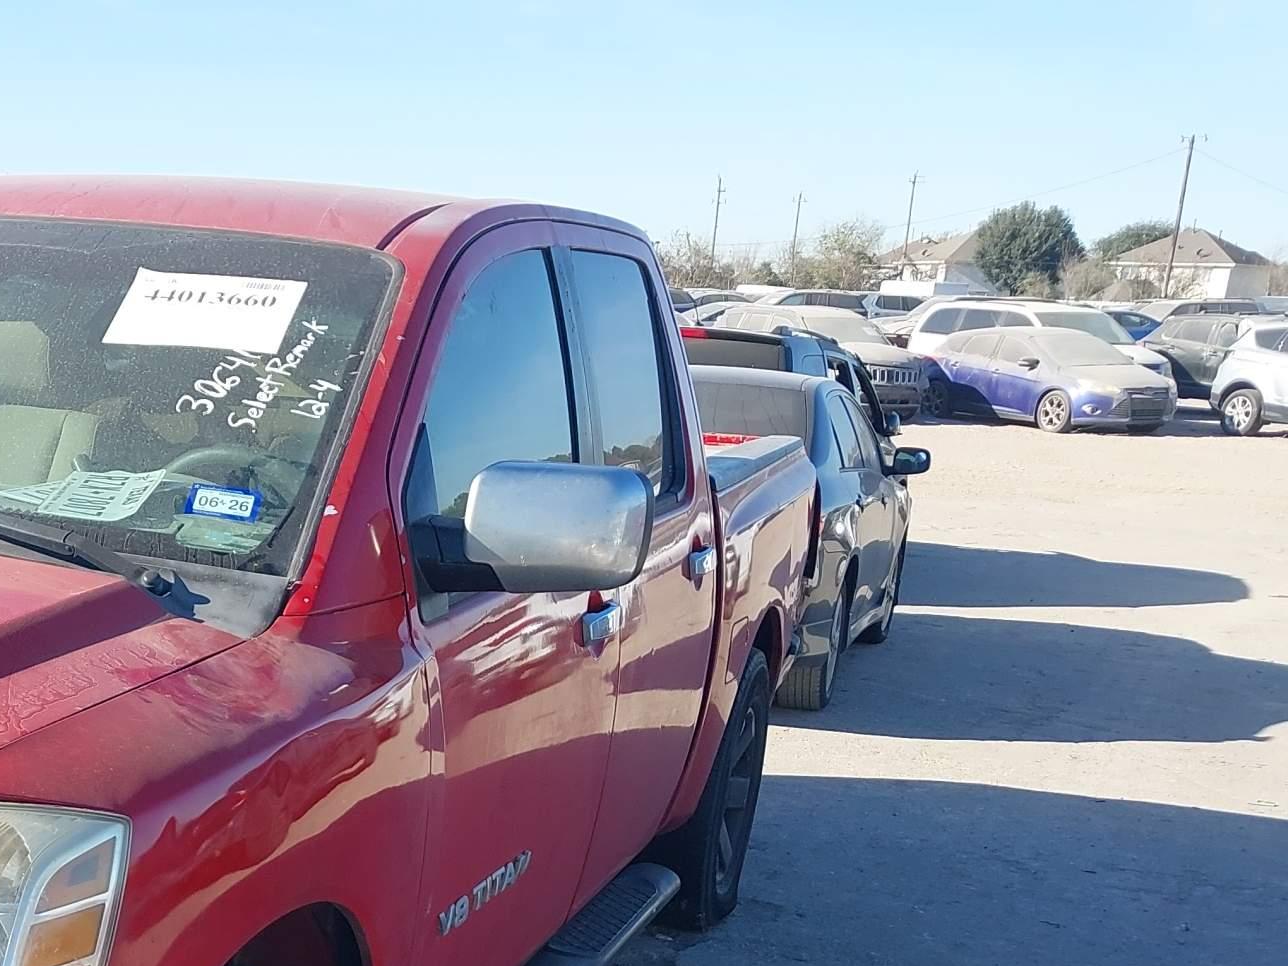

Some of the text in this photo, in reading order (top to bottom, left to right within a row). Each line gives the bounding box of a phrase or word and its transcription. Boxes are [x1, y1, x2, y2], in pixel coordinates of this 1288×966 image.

[144, 289, 277, 307] 44013660
[227, 373, 284, 433] Select
[198, 495, 220, 508] 06
[227, 499, 250, 512] 26
[438, 849, 532, 936] V8 TITAN
